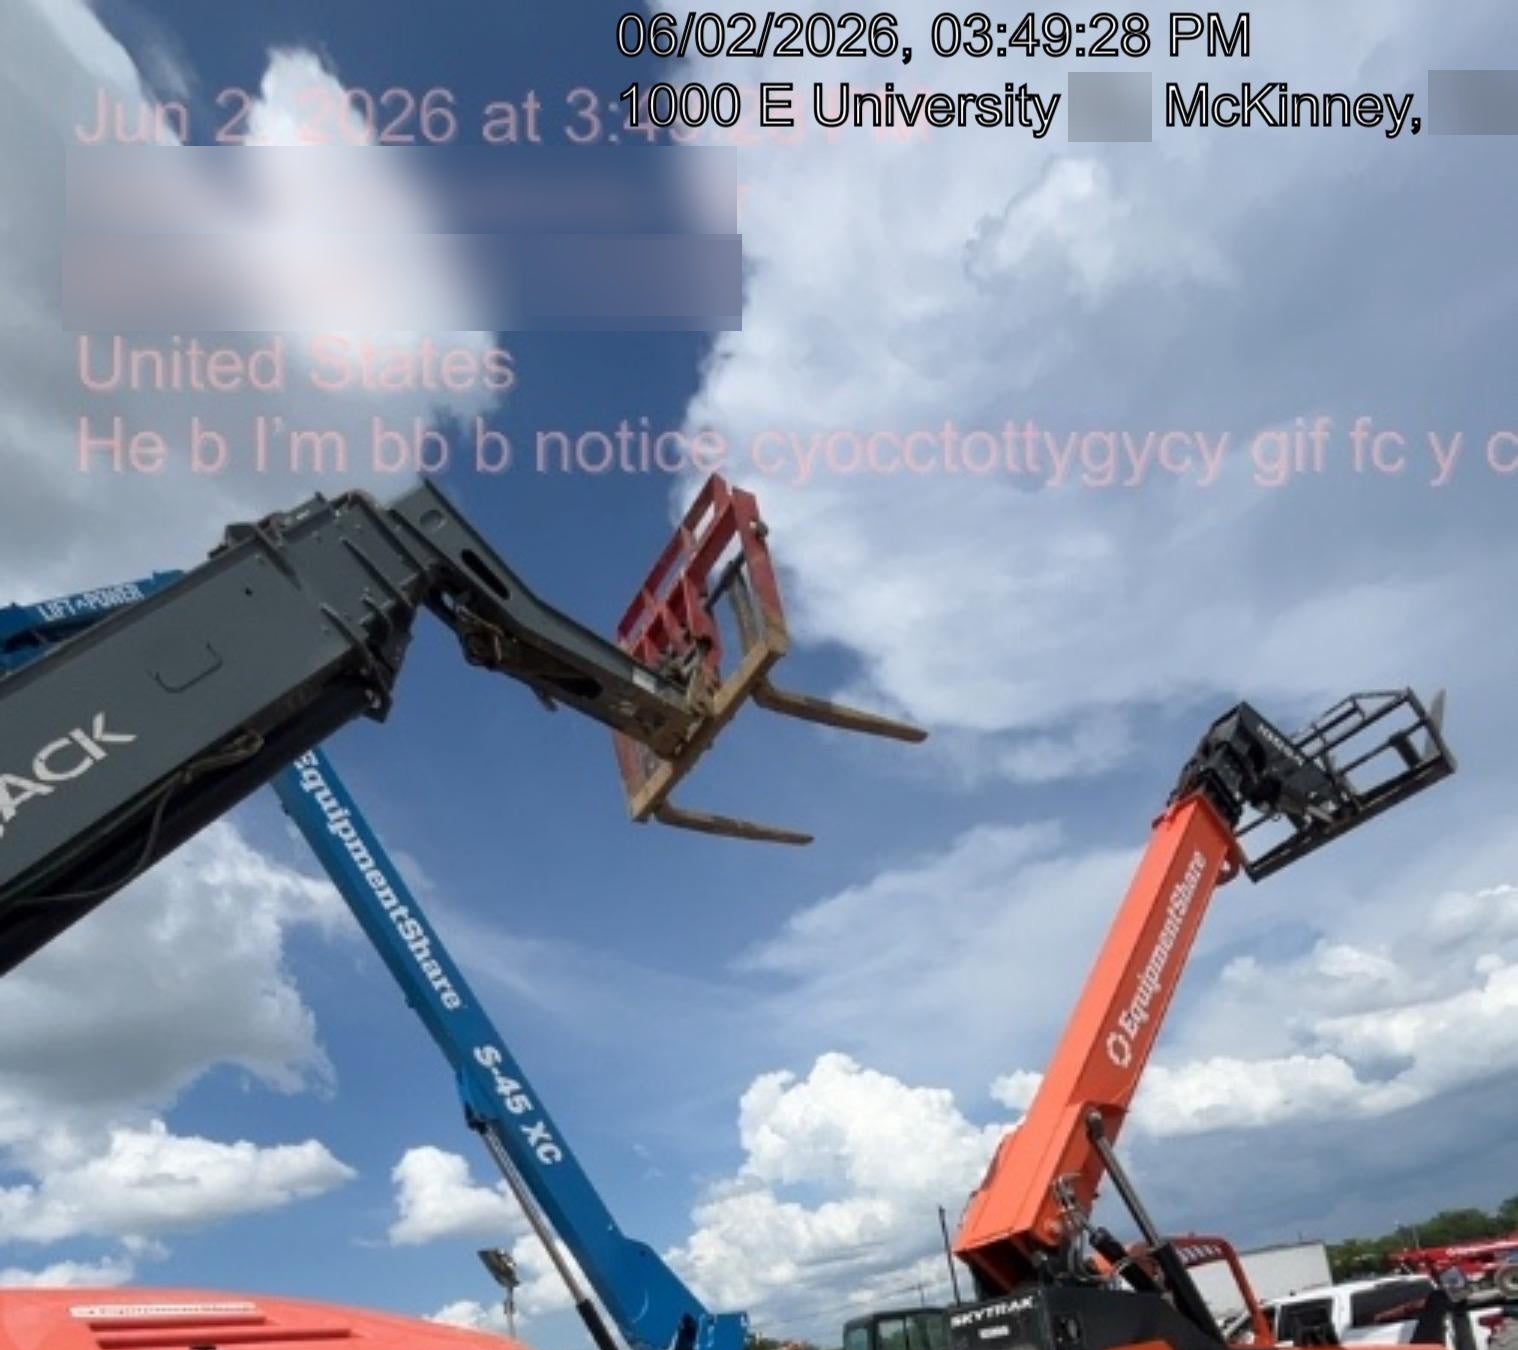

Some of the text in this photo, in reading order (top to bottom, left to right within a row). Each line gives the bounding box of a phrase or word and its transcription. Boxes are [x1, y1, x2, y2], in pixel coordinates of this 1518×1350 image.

[0, 711, 138, 839] ACK
[293, 749, 462, 1011] EquipmentShare
[1117, 850, 1207, 1037] EquipmentShare
[473, 1044, 564, 1166] S-45 XC
[950, 1296, 1034, 1329] SKYTRAK
